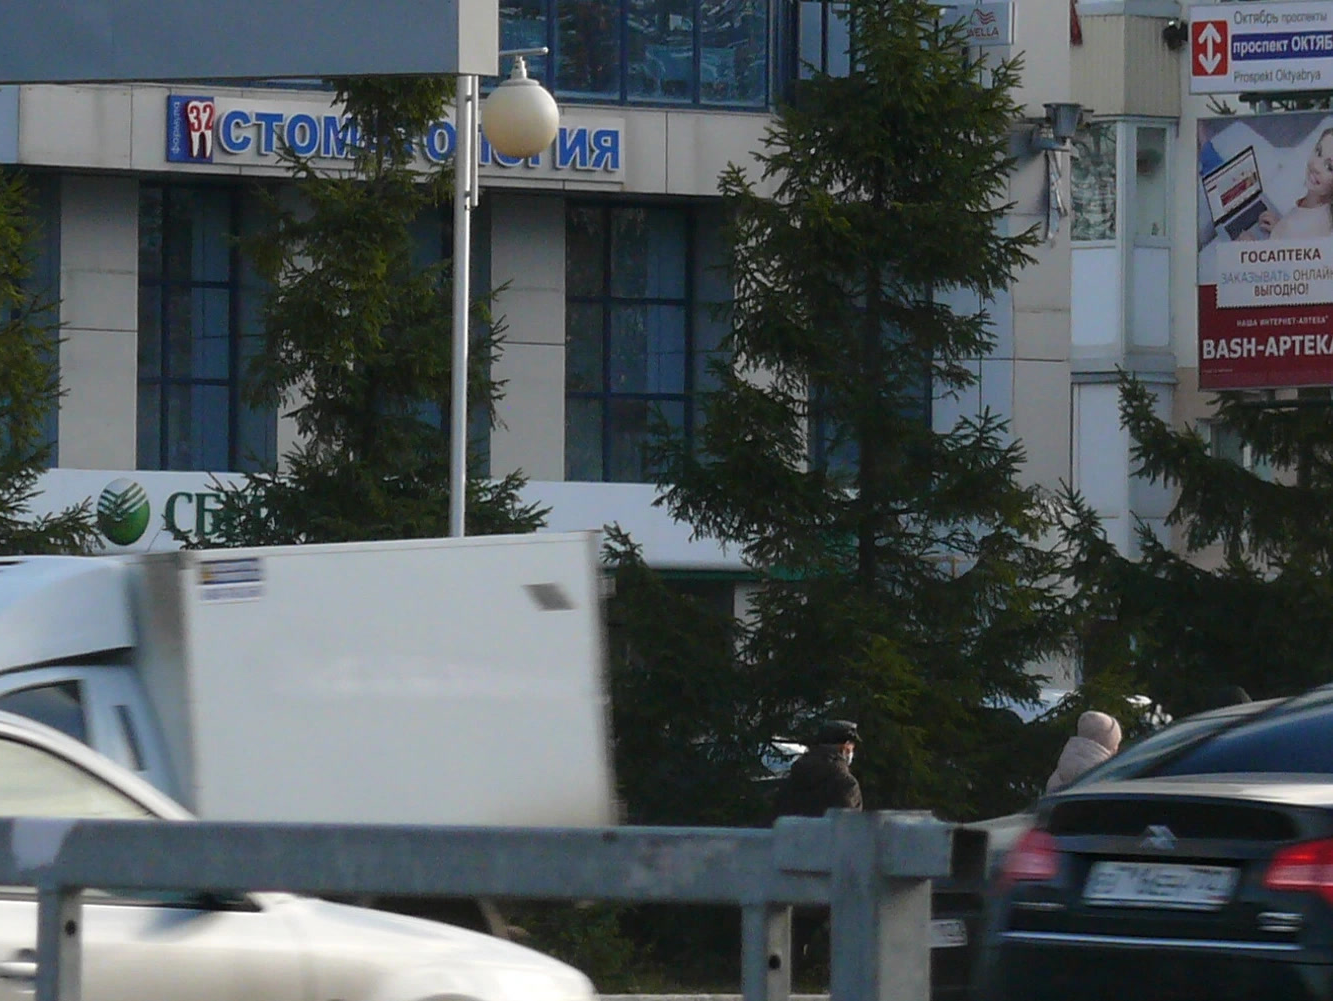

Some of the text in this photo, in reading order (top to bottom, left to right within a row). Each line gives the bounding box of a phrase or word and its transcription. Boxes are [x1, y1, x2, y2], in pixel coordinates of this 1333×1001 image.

[1234, 10, 1278, 27] Октябрь
[1233, 35, 1333, 57] проспект ОКТЯБ
[1234, 71, 1273, 87] Prospekt
[189, 104, 214, 133] 32
[1240, 248, 1322, 264] ГОСАПТЕКА
[1254, 283, 1309, 297] ВЫГОДНО!
